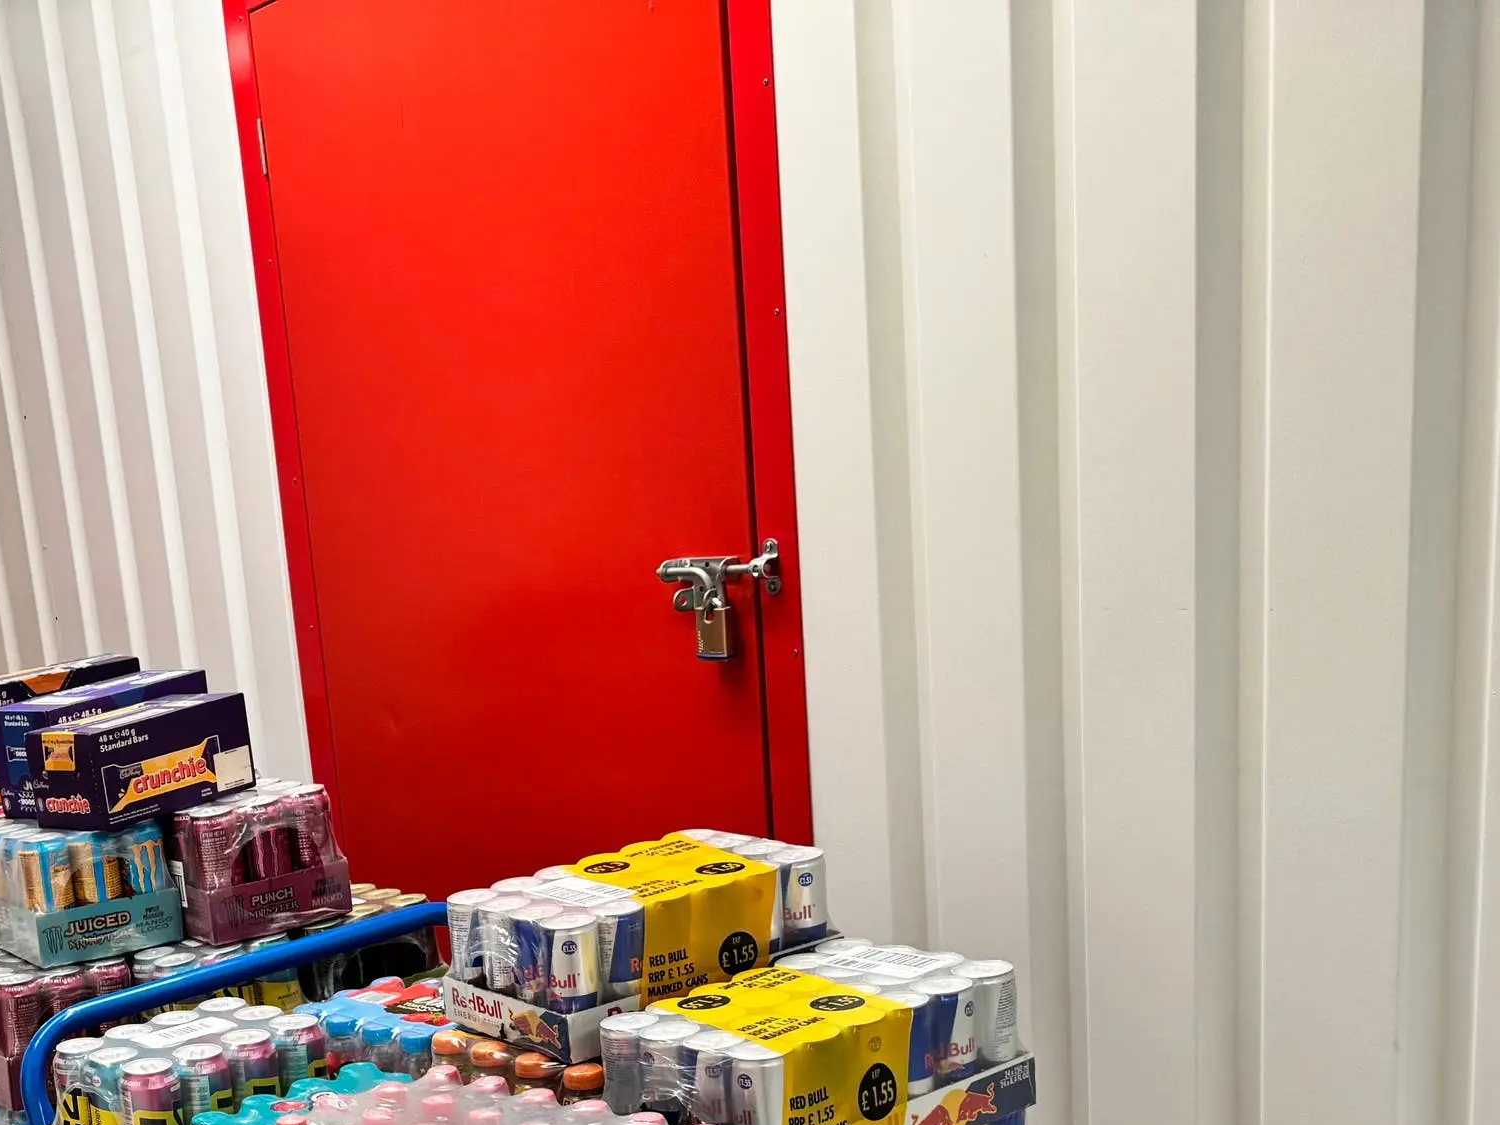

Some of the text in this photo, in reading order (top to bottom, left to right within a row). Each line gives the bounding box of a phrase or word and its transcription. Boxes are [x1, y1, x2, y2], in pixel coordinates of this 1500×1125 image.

[99, 734, 108, 743] 48
[120, 728, 130, 737] 40
[100, 733, 149, 753] Standard Bars
[132, 757, 207, 794] crunchie
[45, 794, 91, 814] crunchie
[251, 887, 294, 907] PUNCH
[64, 911, 131, 938] JUICED
[649, 948, 689, 968] RED BULL
[721, 943, 756, 969] £ 1.55
[648, 963, 695, 984] RRP £ 1.55
[647, 973, 709, 998] MARKED CANS
[789, 1086, 829, 1112] RED BULL
[861, 1080, 894, 1112] £ 1.55
[817, 1104, 835, 1125] 1.55
